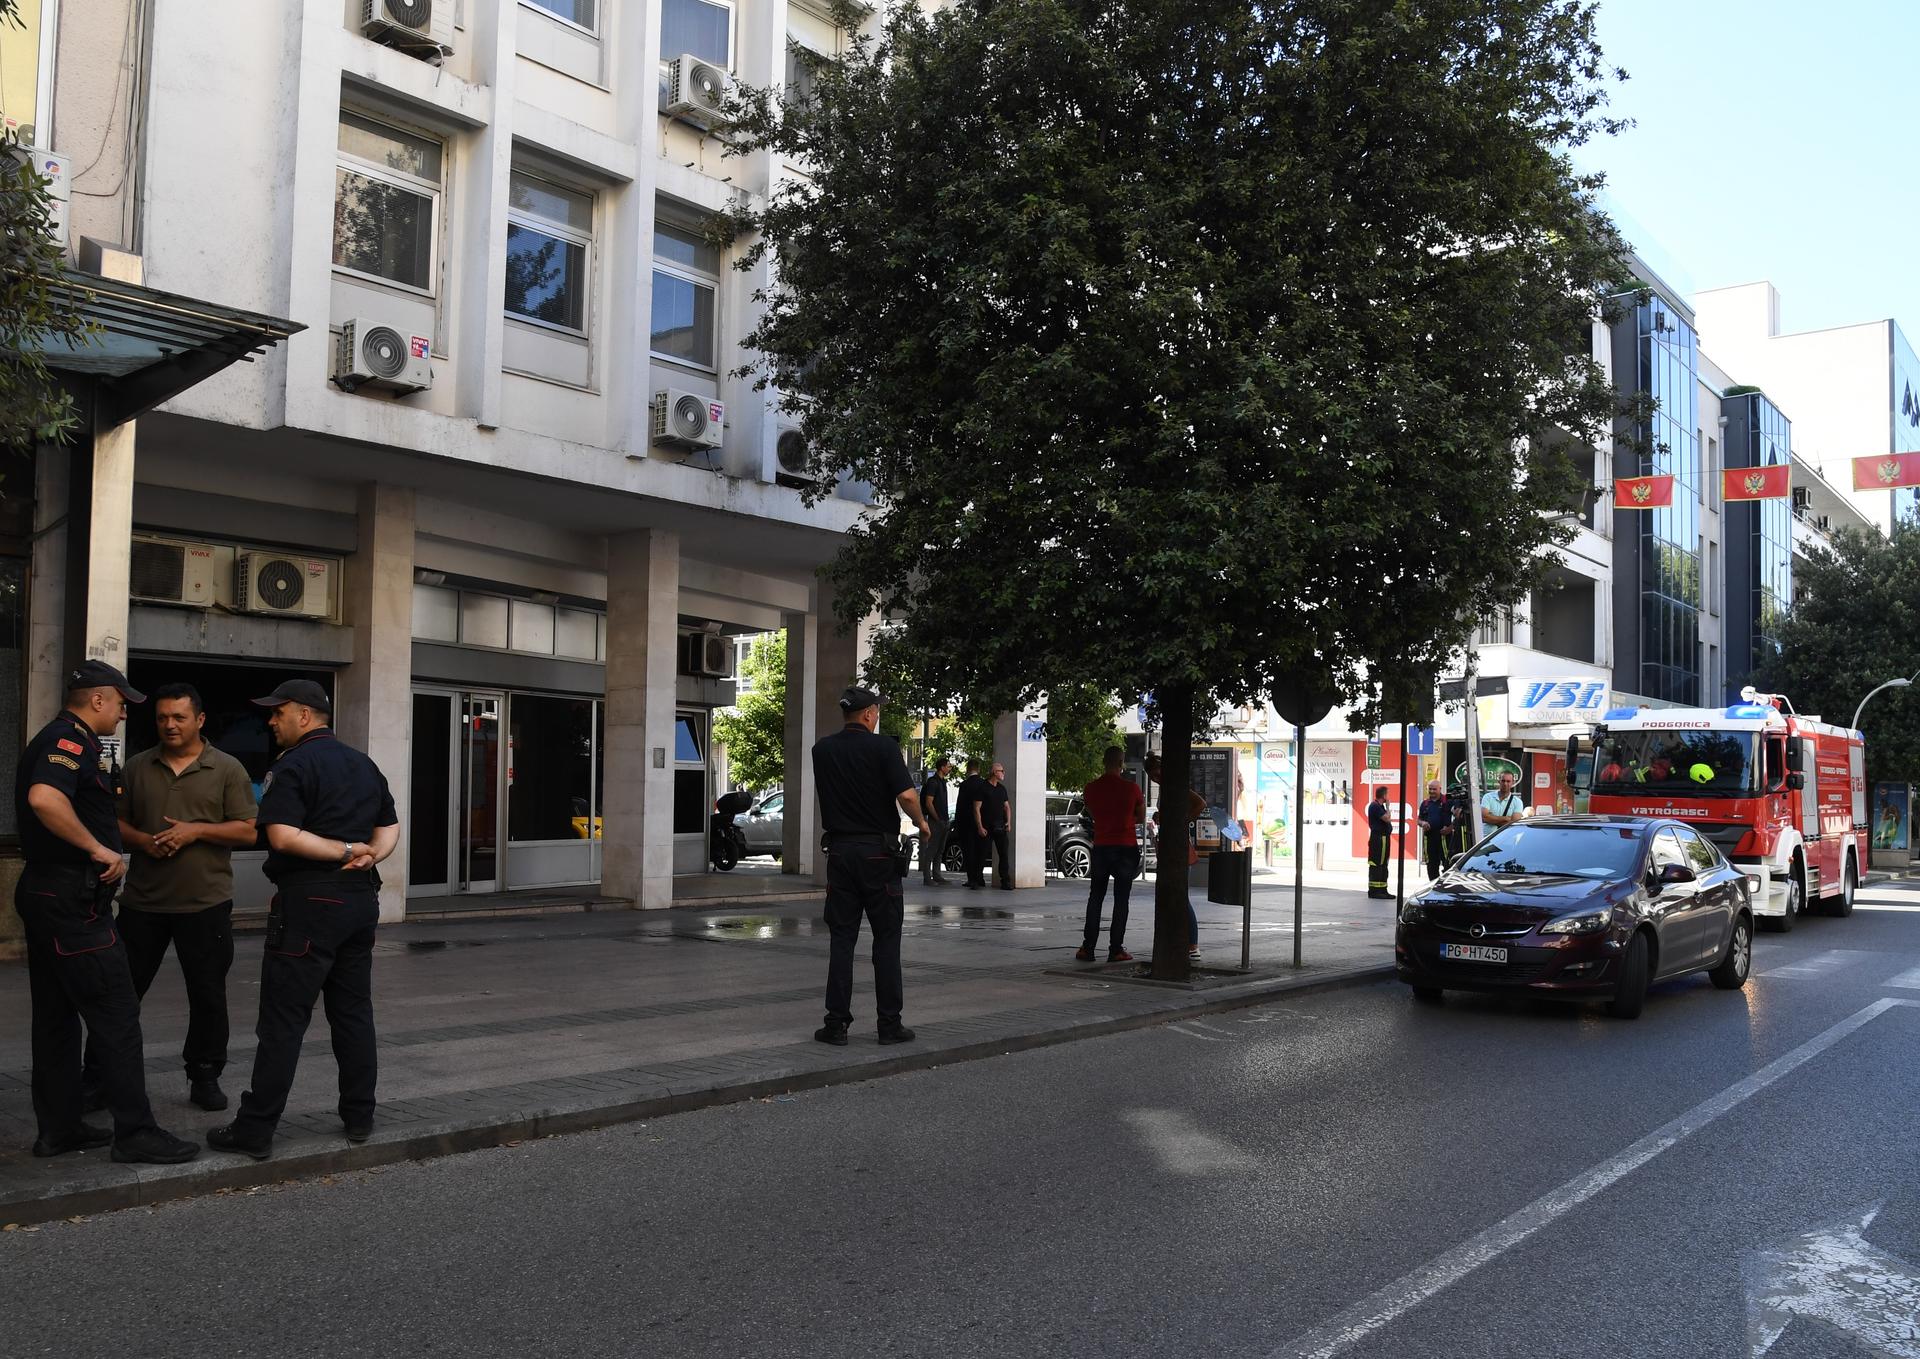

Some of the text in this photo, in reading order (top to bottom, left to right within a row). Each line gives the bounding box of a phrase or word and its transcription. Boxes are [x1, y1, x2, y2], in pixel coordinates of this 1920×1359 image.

[190, 549, 210, 558] VIVAX
[1528, 711, 1598, 721] COMMERCE
[50, 755, 79, 770] POLICIJA
[1631, 807, 1709, 817] VATROGASCI
[1447, 945, 1462, 957] PG
